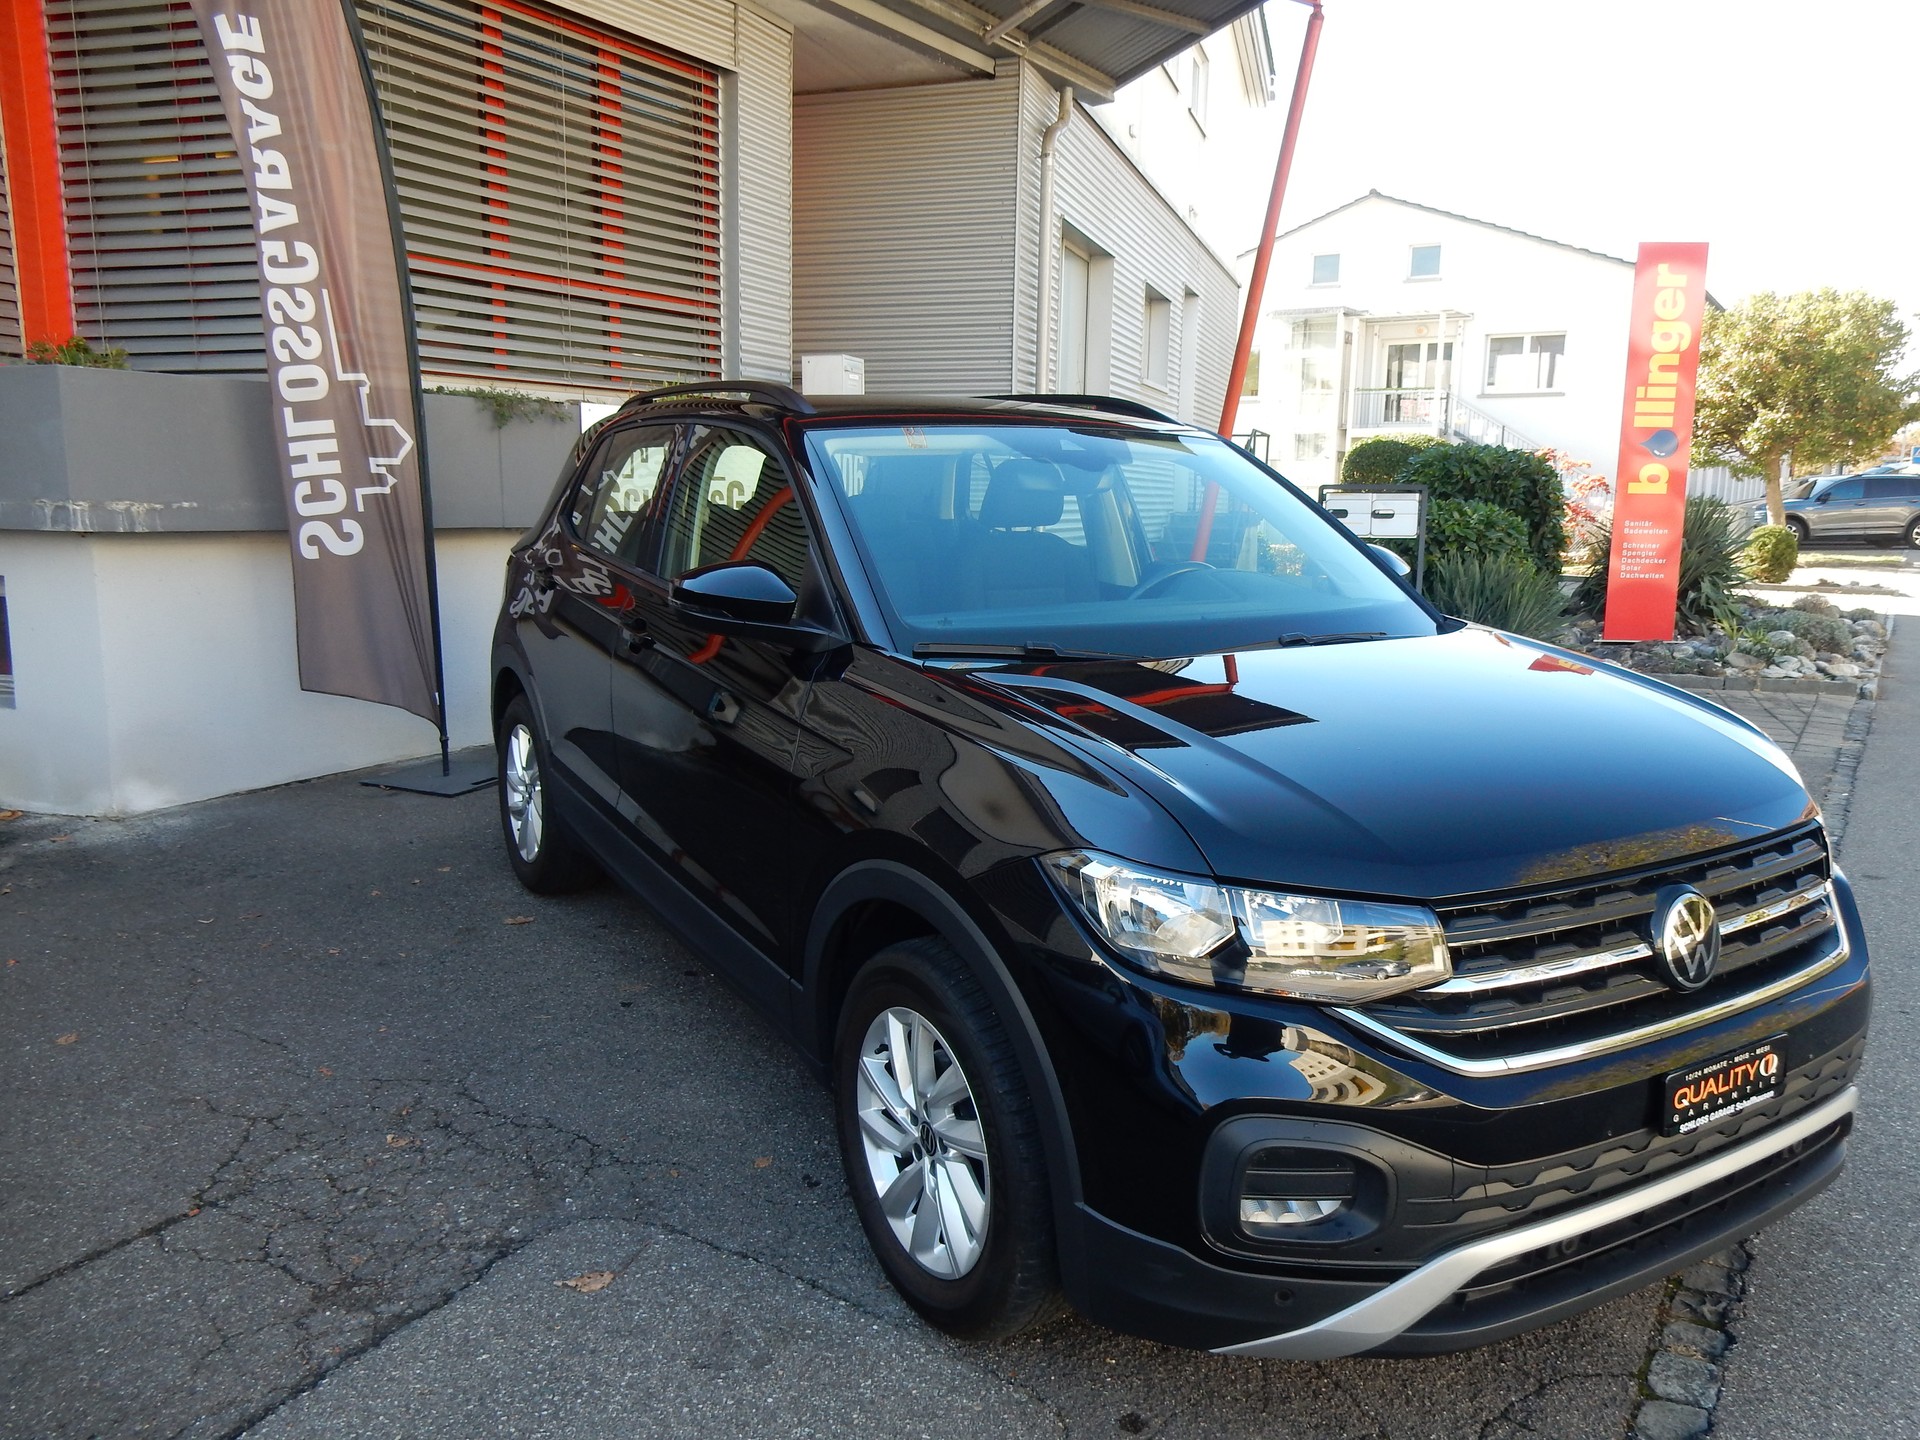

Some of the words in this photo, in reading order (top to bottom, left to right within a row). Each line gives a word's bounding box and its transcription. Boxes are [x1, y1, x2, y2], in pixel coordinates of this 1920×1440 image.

[1703, 1060, 1728, 1074] MONATE
[1680, 1114, 1710, 1134] SCHLOSS
[1710, 1104, 1736, 1121] GARAGE
